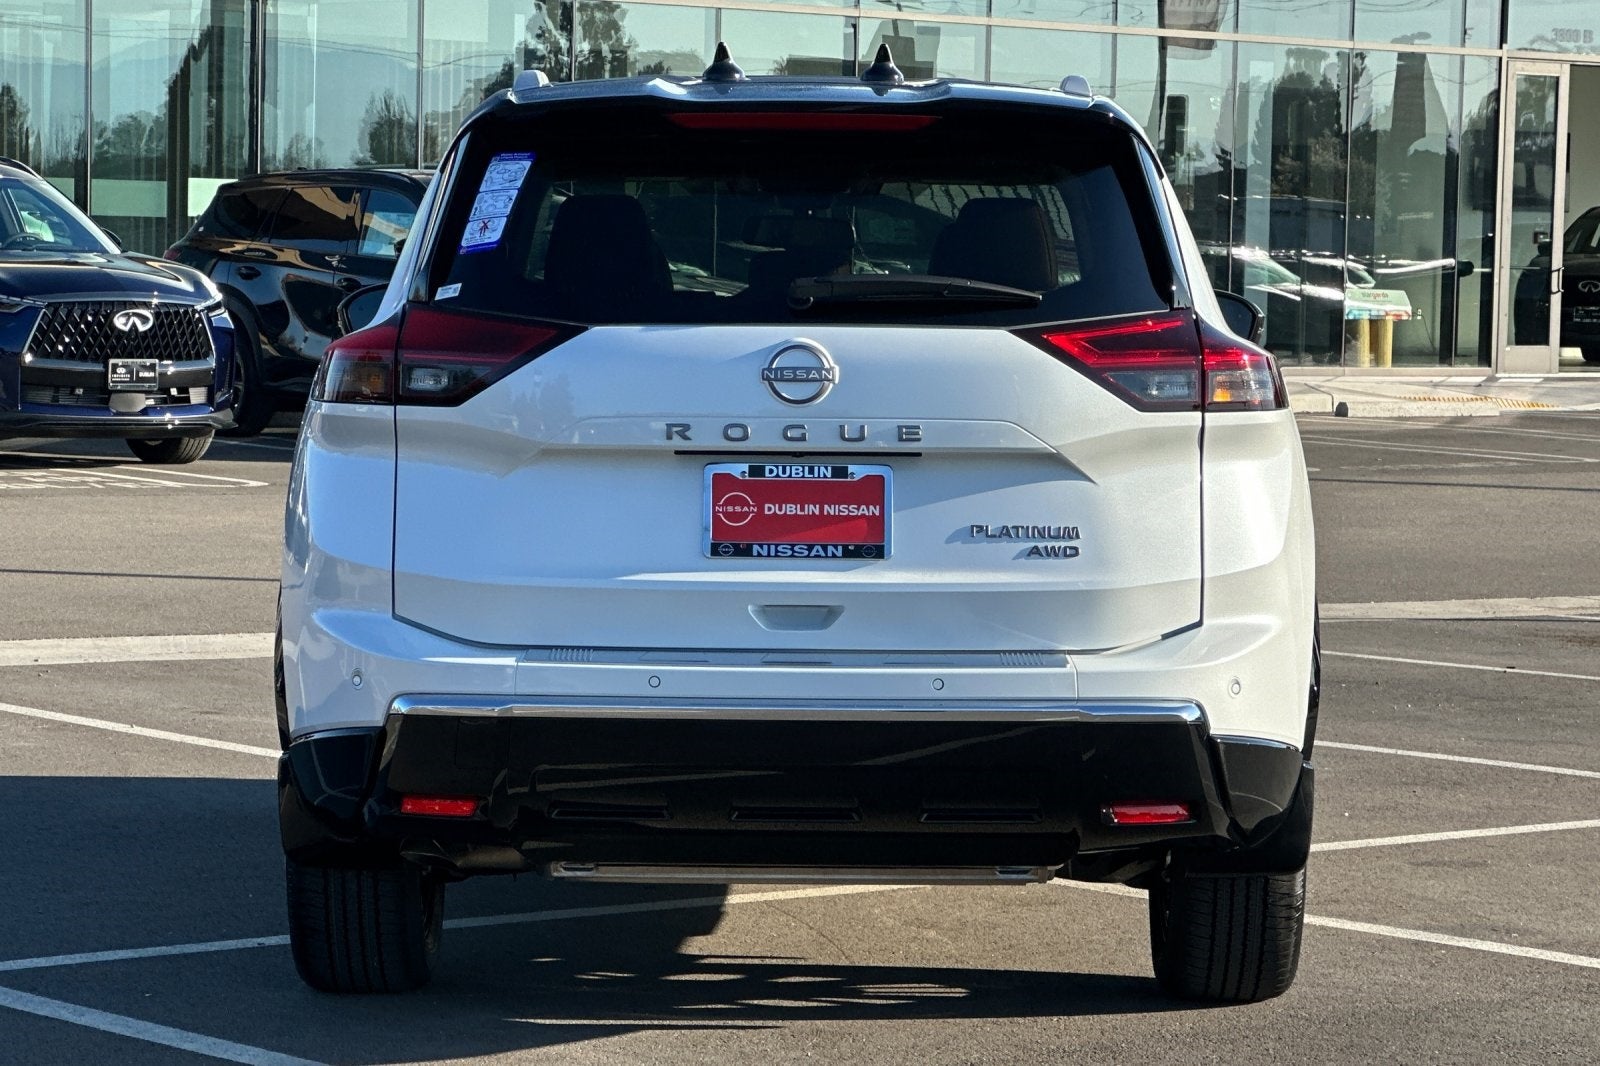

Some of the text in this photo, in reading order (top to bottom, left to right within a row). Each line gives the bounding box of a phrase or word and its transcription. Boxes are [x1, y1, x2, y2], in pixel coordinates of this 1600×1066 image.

[763, 369, 833, 379] NISSAN
[665, 422, 922, 442] ROGUE
[764, 465, 832, 478] DUBLIN
[715, 505, 758, 513] NISSAN
[764, 503, 880, 517] DUBLIN NISSAN
[970, 524, 1081, 540] PLATINUM
[752, 544, 843, 557] NISSAN
[1026, 545, 1080, 558] AWD
